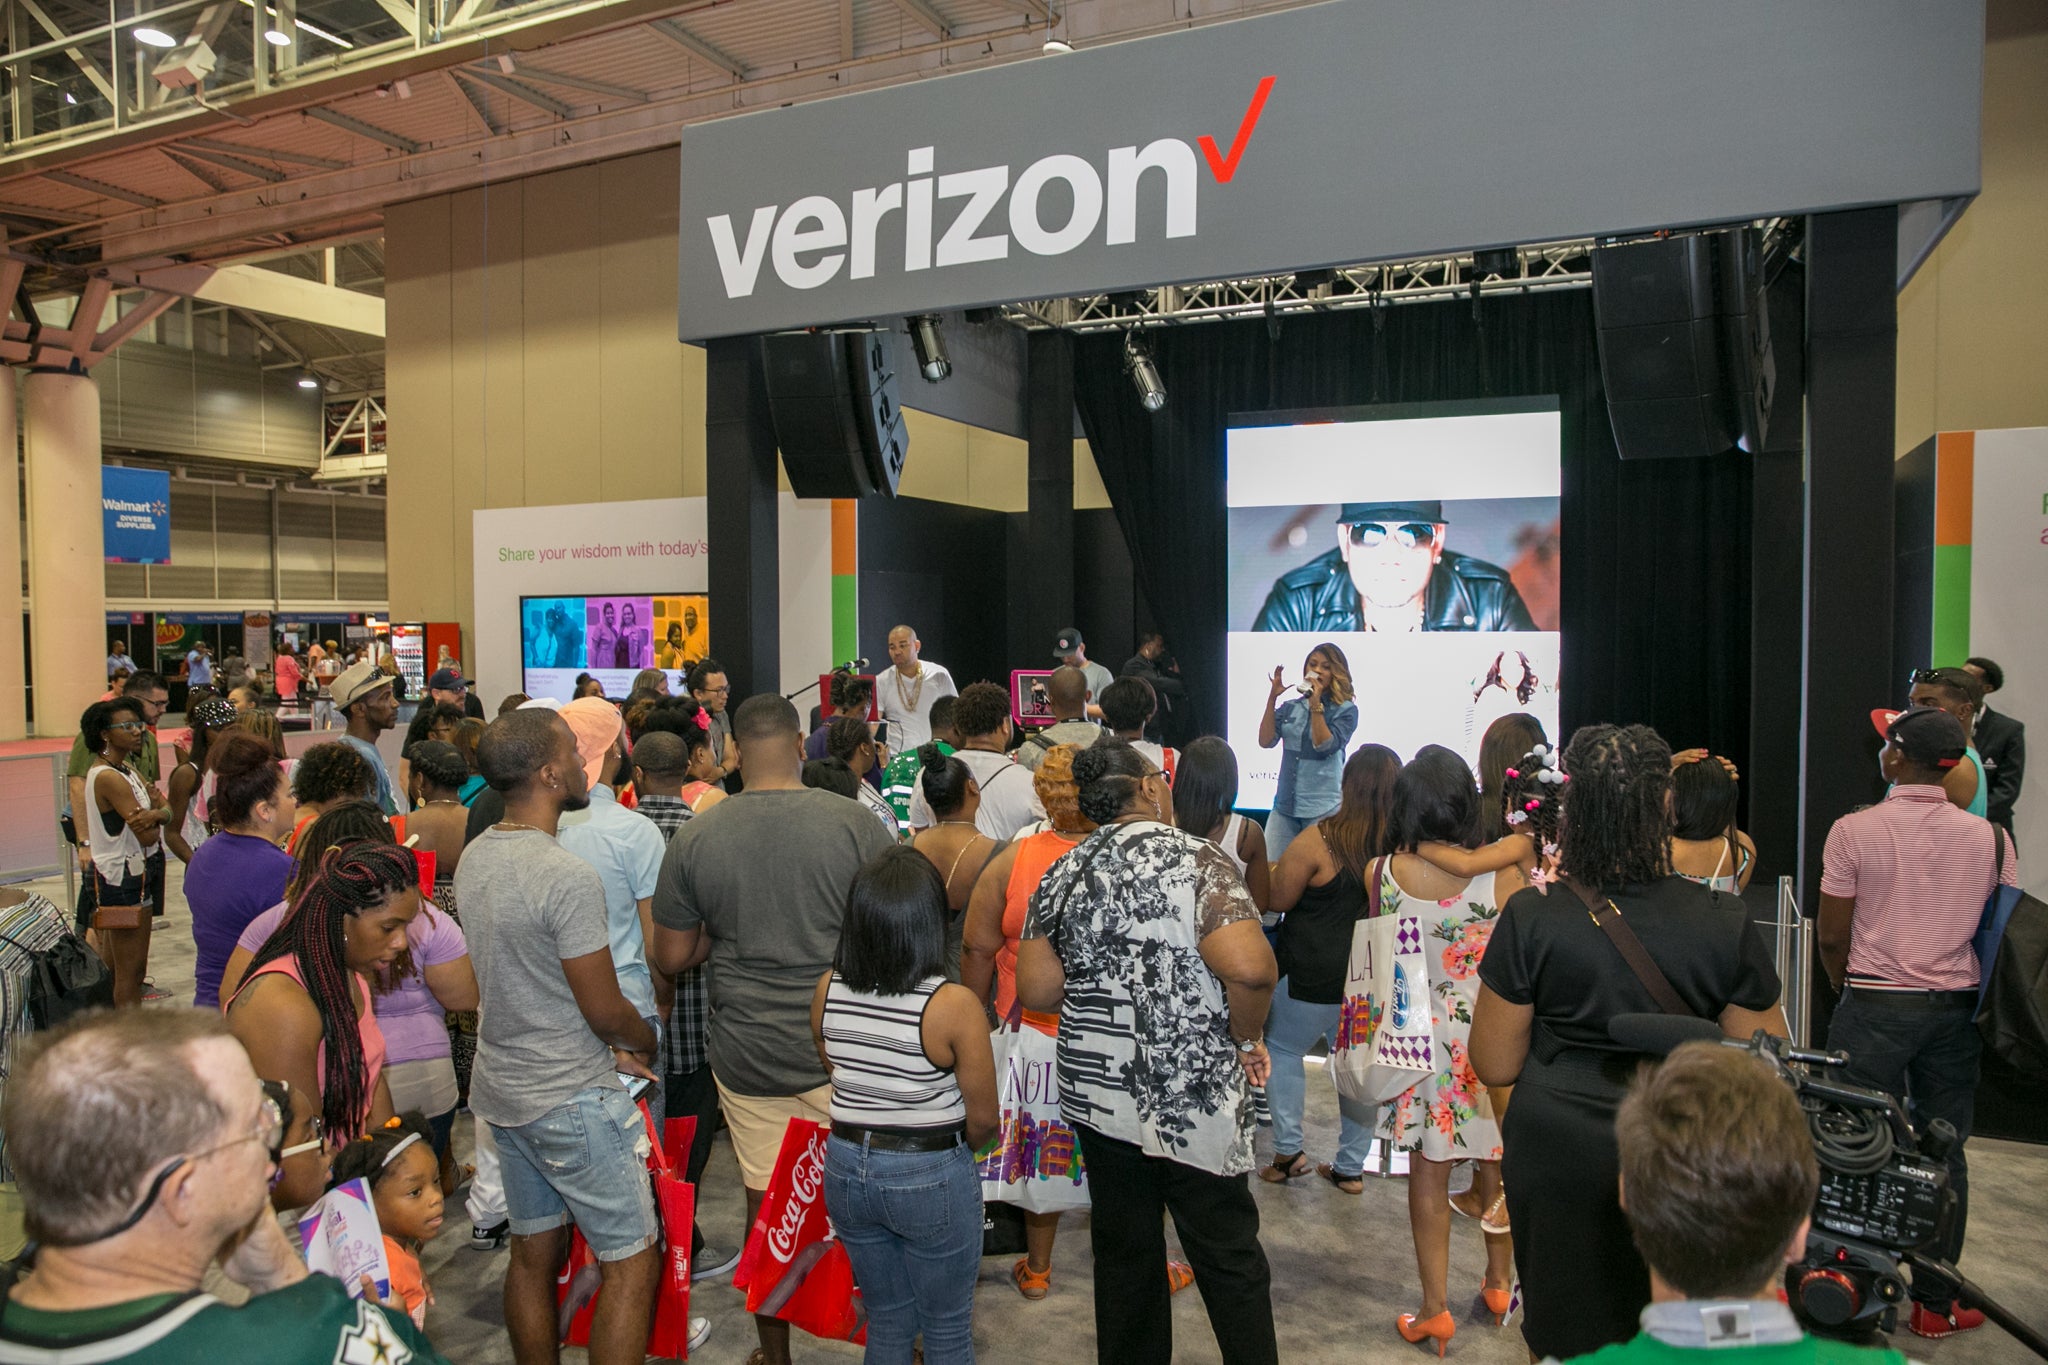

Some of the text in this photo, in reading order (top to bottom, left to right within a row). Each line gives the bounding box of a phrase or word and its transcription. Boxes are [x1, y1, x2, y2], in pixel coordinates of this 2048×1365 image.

[707, 137, 1198, 299] verizon
[102, 499, 151, 513] Walmart
[116, 521, 156, 530] SUPPLIERS
[120, 515, 152, 523] DIVERSE
[499, 539, 709, 563] Share your wisdom with today's
[1899, 1164, 1935, 1181] SONY
